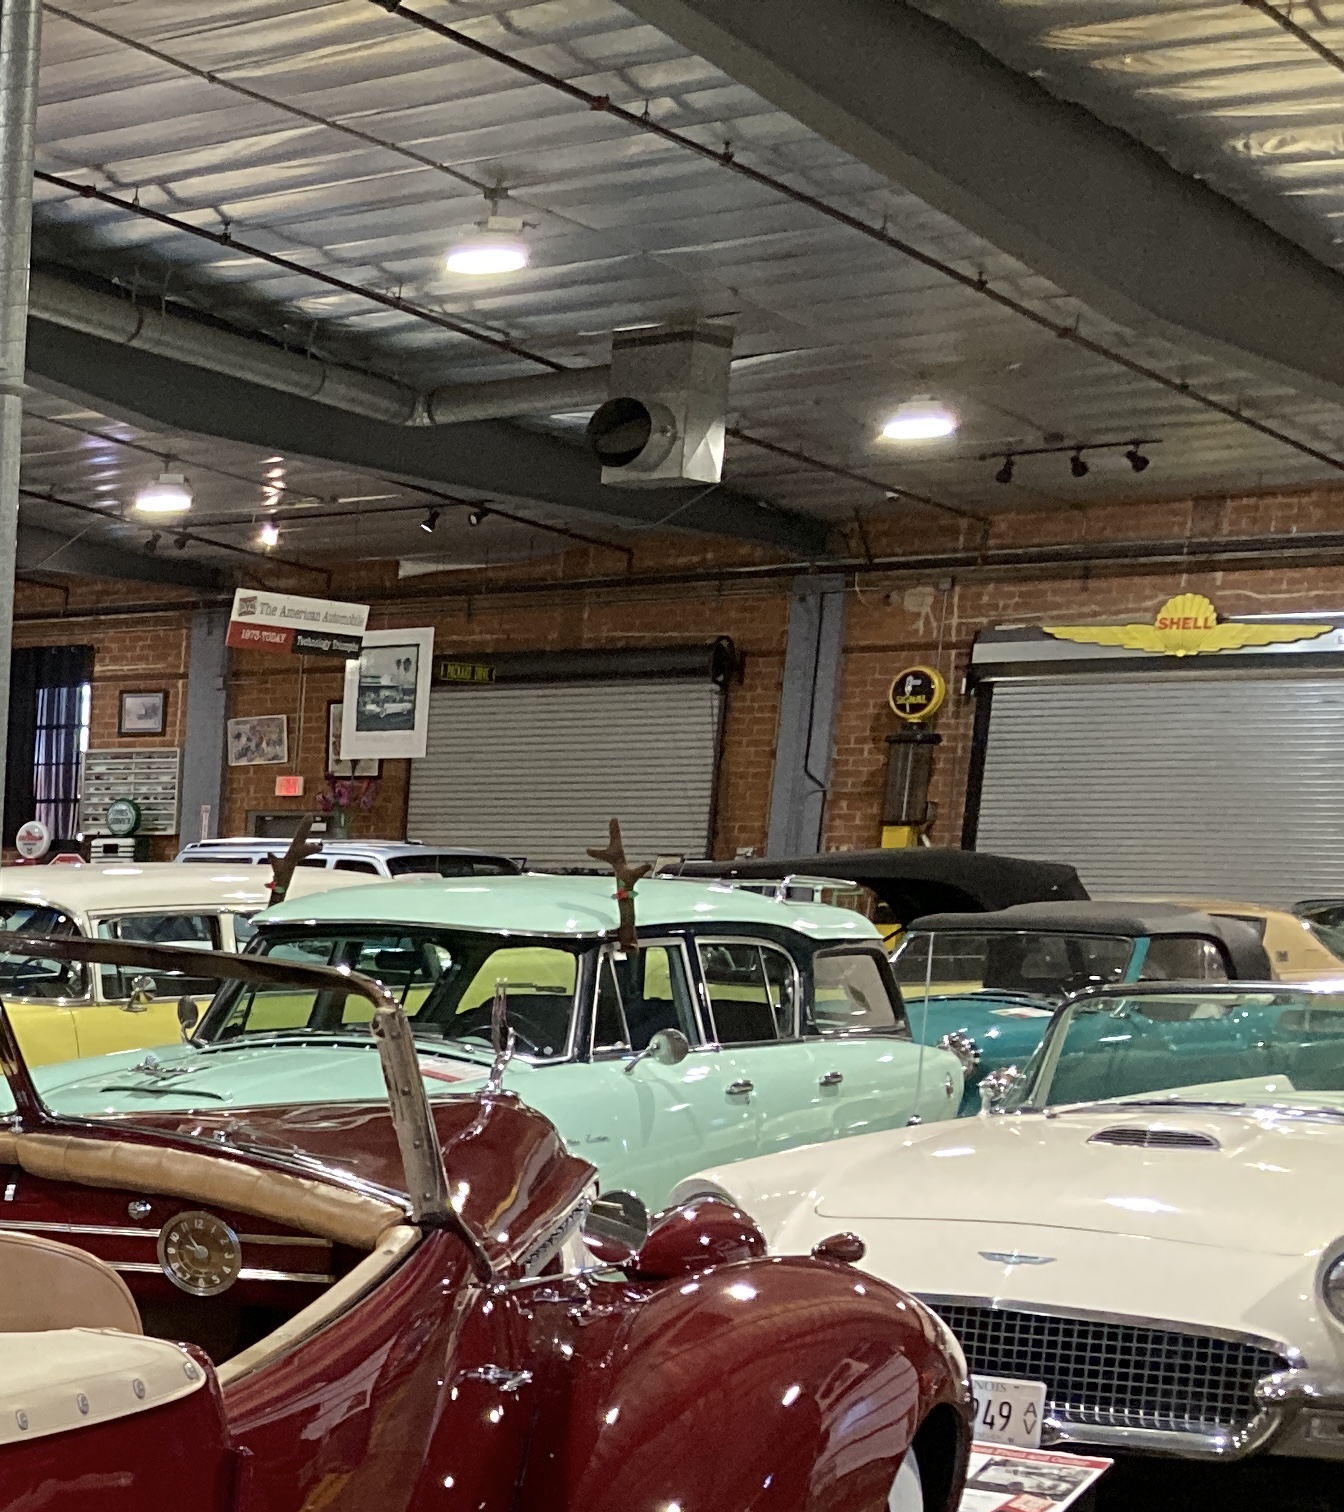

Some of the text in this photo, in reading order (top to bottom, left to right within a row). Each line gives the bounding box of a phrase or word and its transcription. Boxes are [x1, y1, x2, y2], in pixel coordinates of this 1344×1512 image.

[259, 602, 278, 616] The
[279, 605, 321, 622] American
[1157, 617, 1213, 631] SHELL
[973, 1380, 1007, 1392] NOIS
